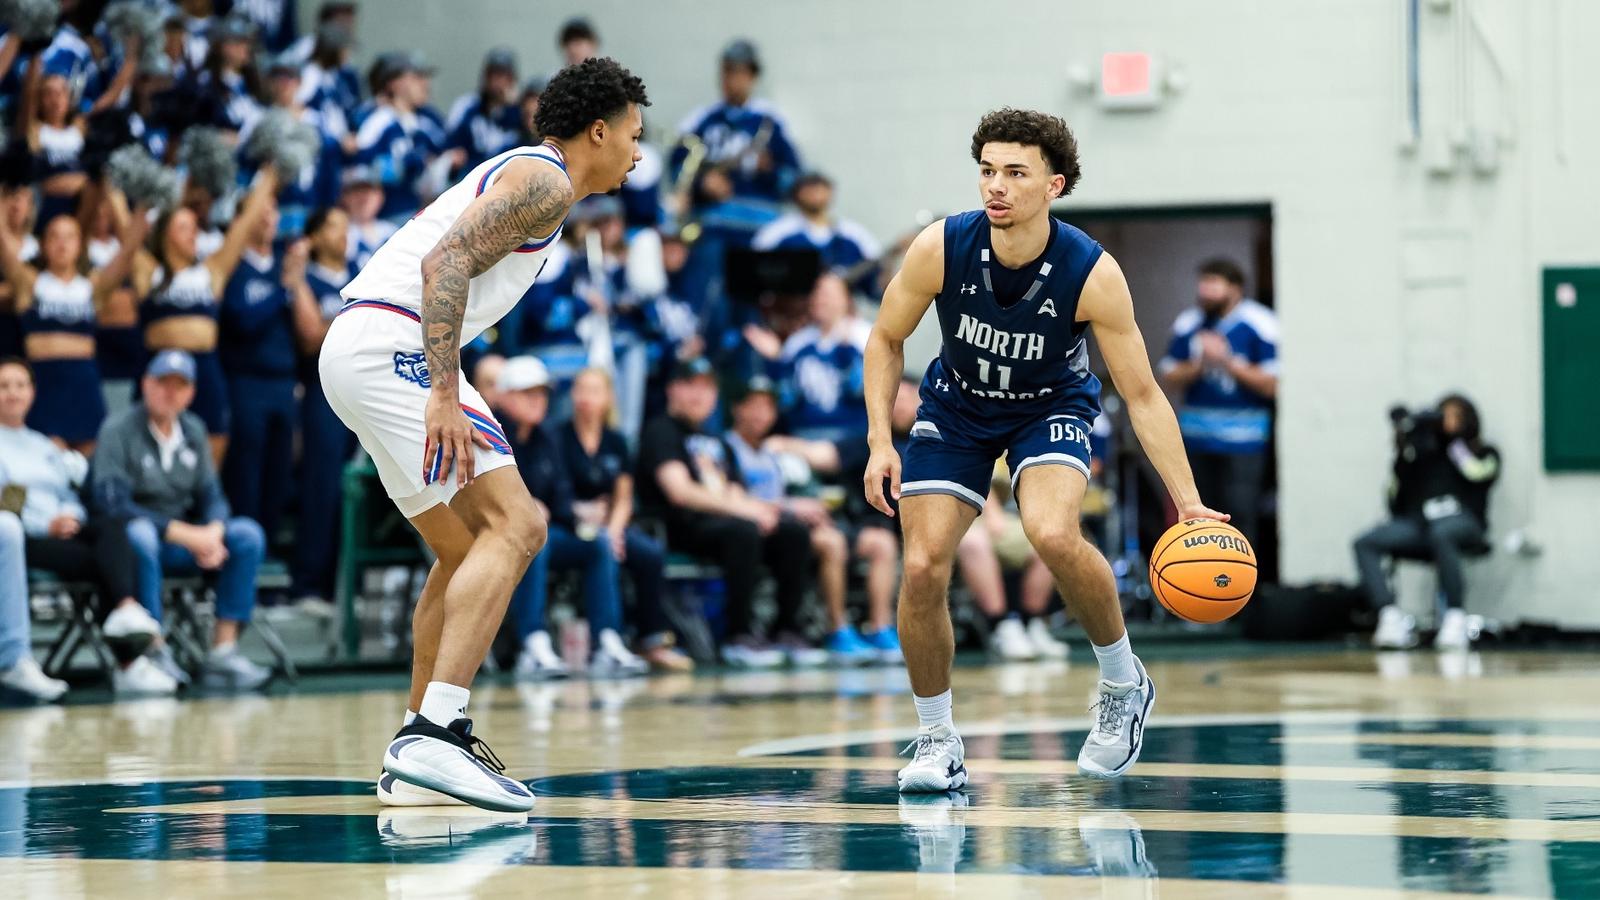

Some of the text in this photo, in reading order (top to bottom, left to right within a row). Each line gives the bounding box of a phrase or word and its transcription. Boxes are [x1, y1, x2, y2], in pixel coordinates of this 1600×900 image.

[954, 313, 1045, 361] NORTH
[976, 356, 1012, 390] 11
[1183, 534, 1251, 557] Wilson
